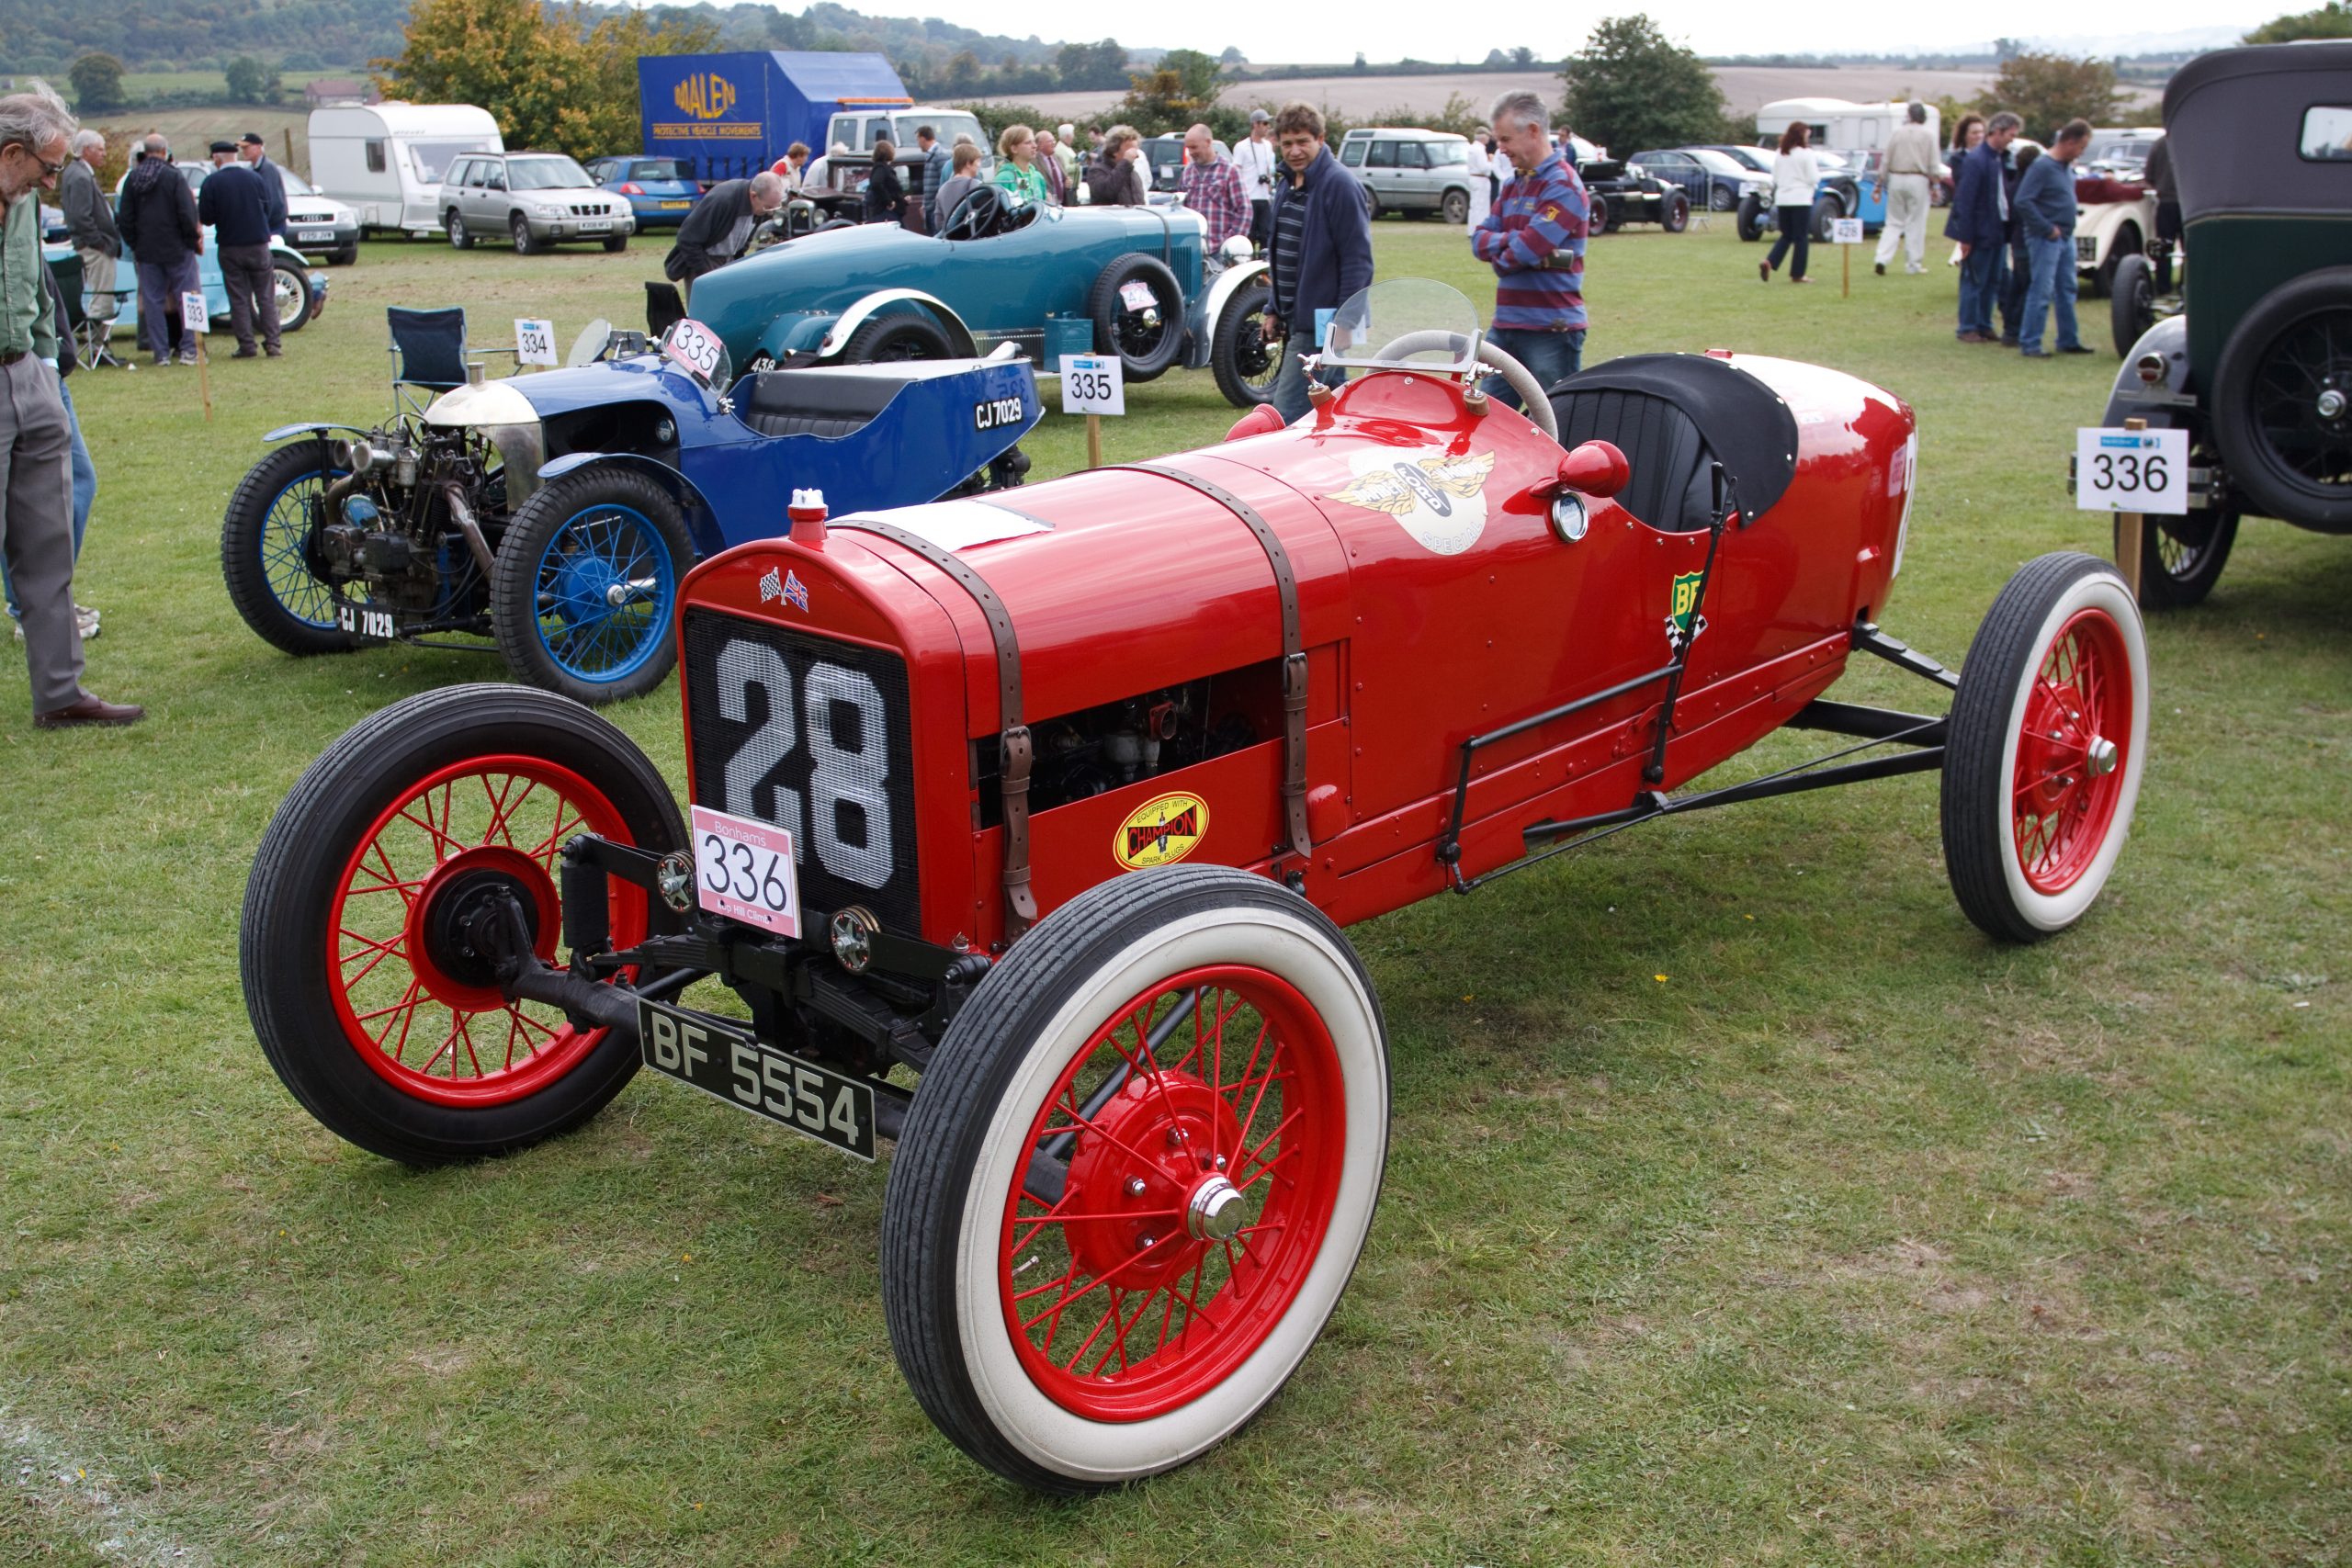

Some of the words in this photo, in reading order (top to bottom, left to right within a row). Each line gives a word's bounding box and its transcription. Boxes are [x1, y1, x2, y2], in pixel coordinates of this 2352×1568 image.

[673, 73, 735, 119] MALEN
[522, 333, 548, 354] 334
[676, 324, 718, 371] 335
[1070, 372, 1112, 400] 335
[976, 402, 992, 429] CJ
[993, 397, 1023, 425] 7029
[1396, 467, 1442, 511] FORD
[2093, 454, 2168, 493] 336
[1423, 521, 1482, 553] SPECIAL
[340, 607, 356, 632] CJ
[362, 610, 394, 638] 7029
[716, 638, 895, 890] 28
[1136, 802, 1169, 823] EQUIPPED
[1172, 799, 1188, 807] WITH
[714, 820, 766, 846] Bonhams
[1128, 804, 1196, 856] CHAMPION
[1141, 855, 1162, 864] SPARK
[1164, 843, 1185, 860] PLUGS
[705, 834, 787, 912] 336
[733, 903, 745, 915] Hill
[651, 1011, 708, 1077] BF
[731, 1043, 859, 1146] 5554
